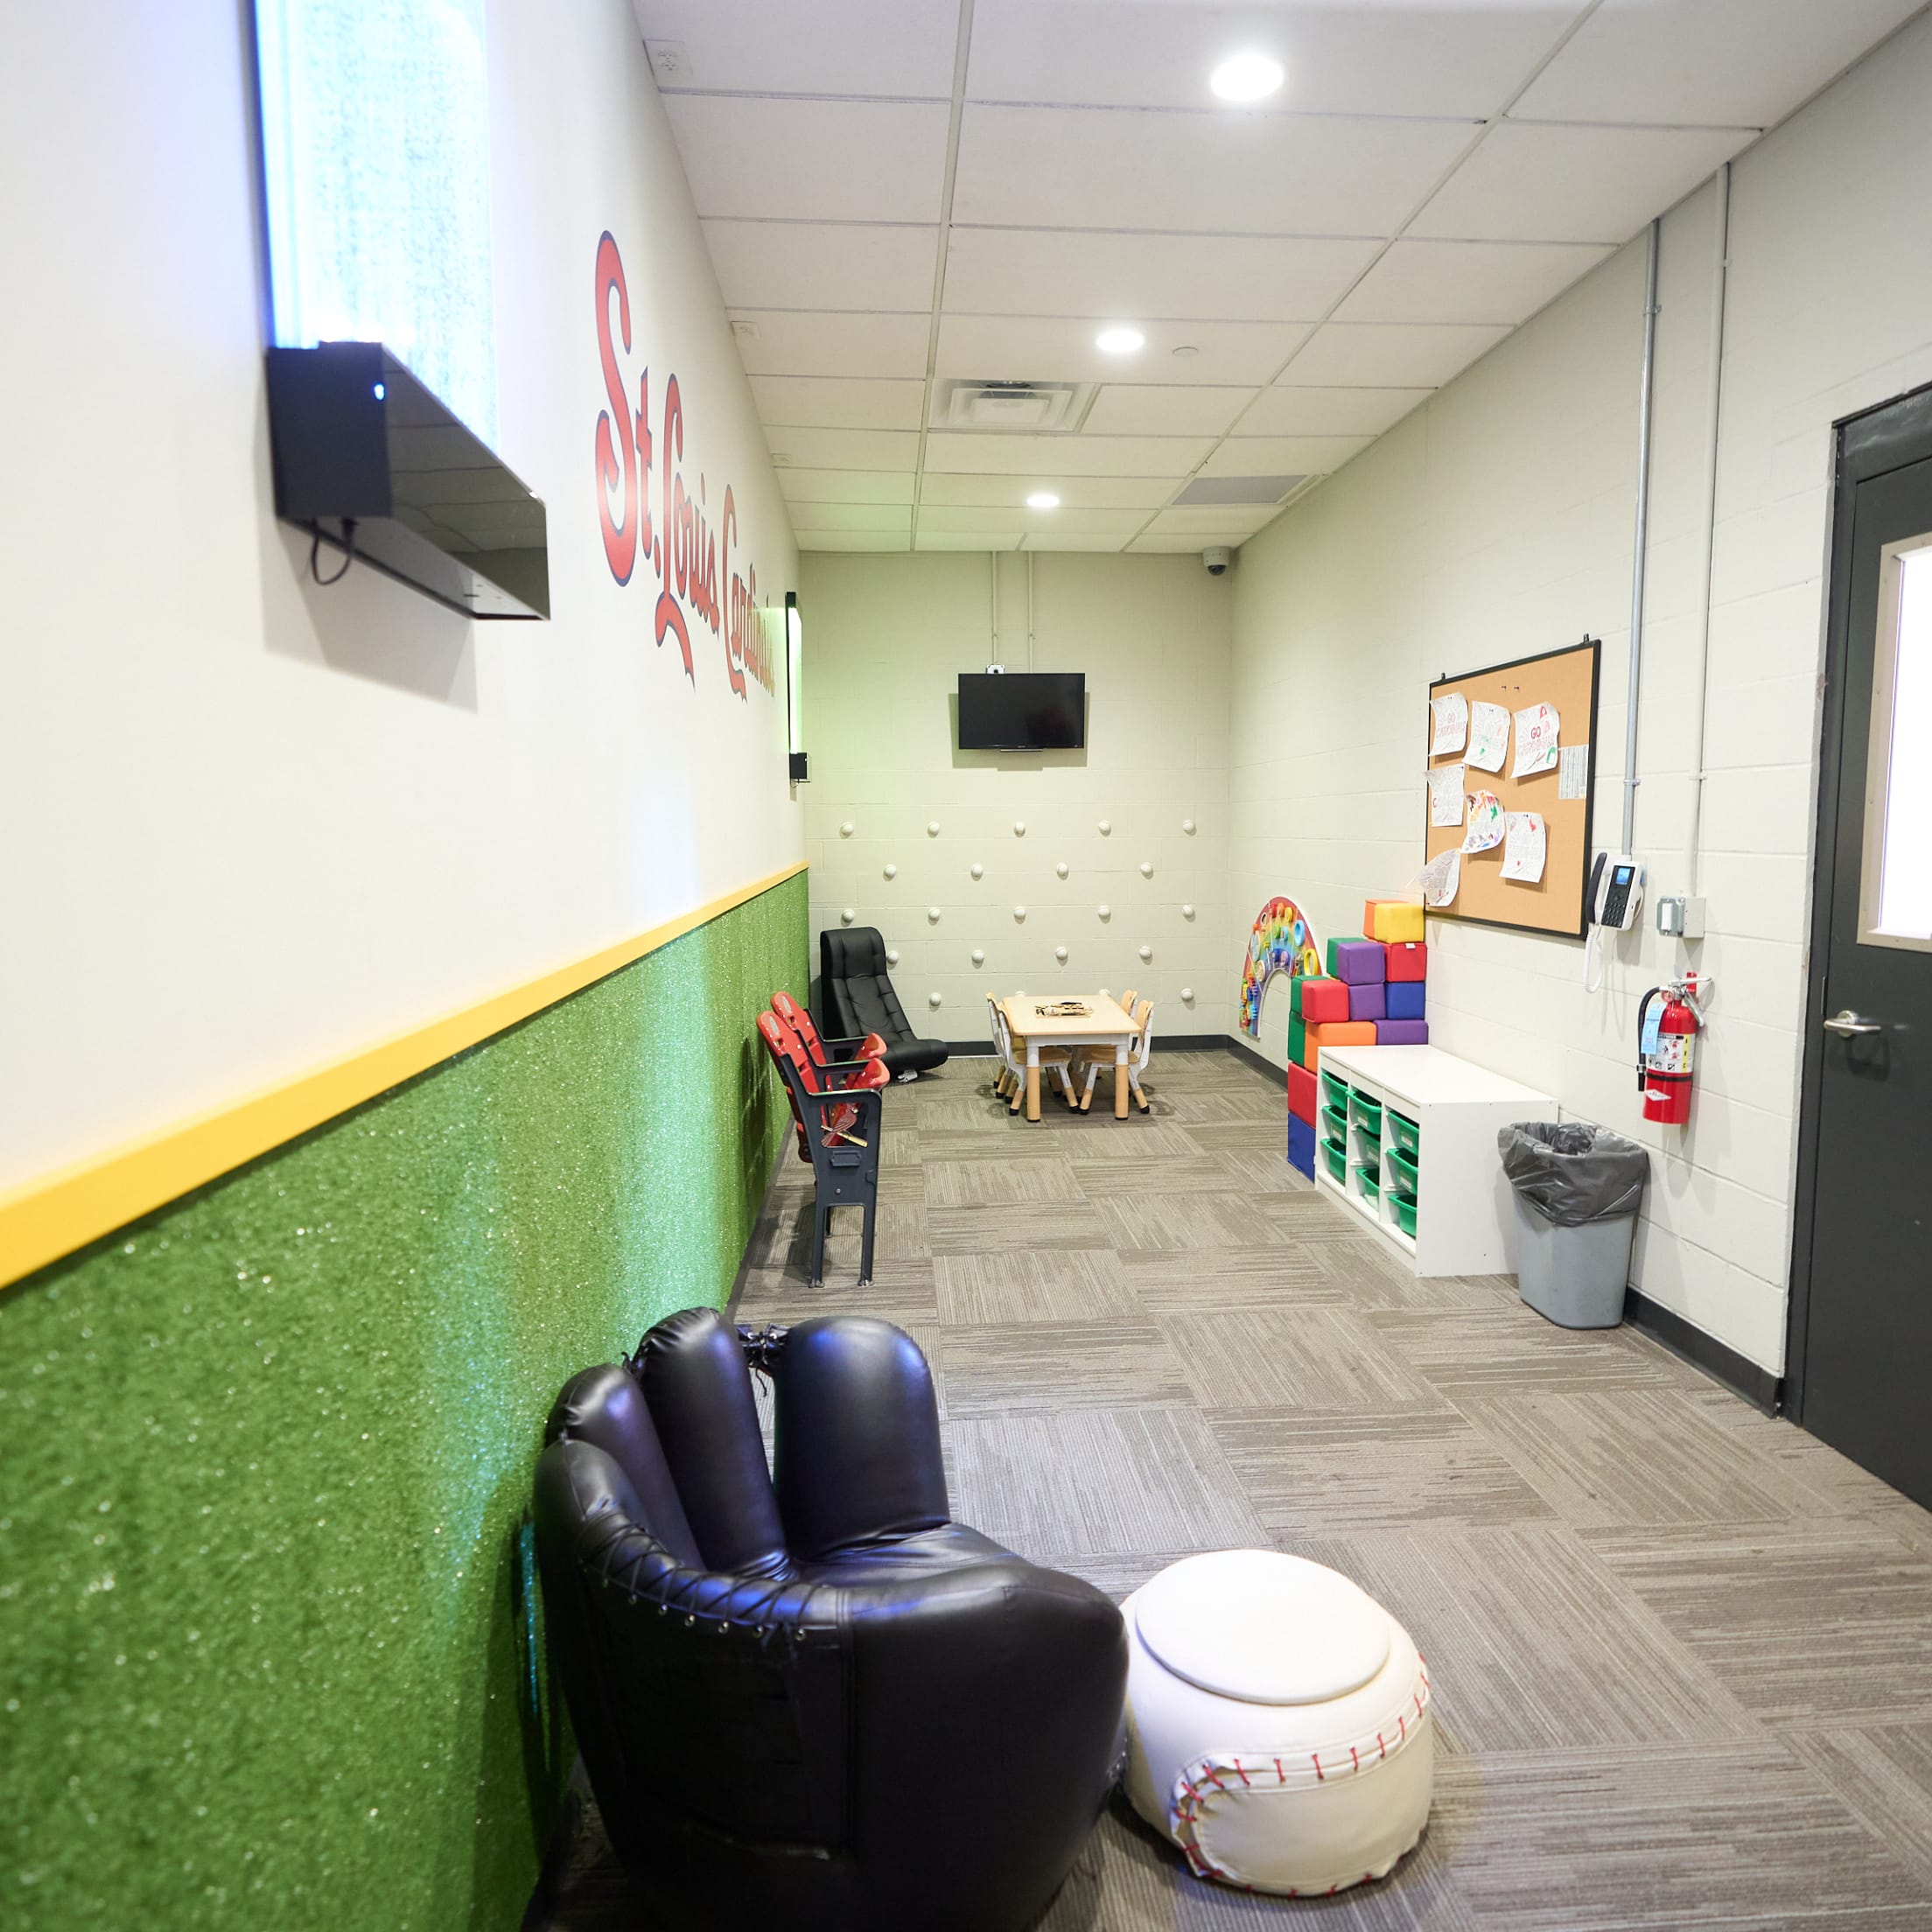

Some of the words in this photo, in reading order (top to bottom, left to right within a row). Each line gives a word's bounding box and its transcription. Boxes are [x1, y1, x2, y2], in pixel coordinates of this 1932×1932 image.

[595, 230, 661, 587] St.
[654, 373, 720, 692] Louis
[1530, 725, 1542, 739] GO
